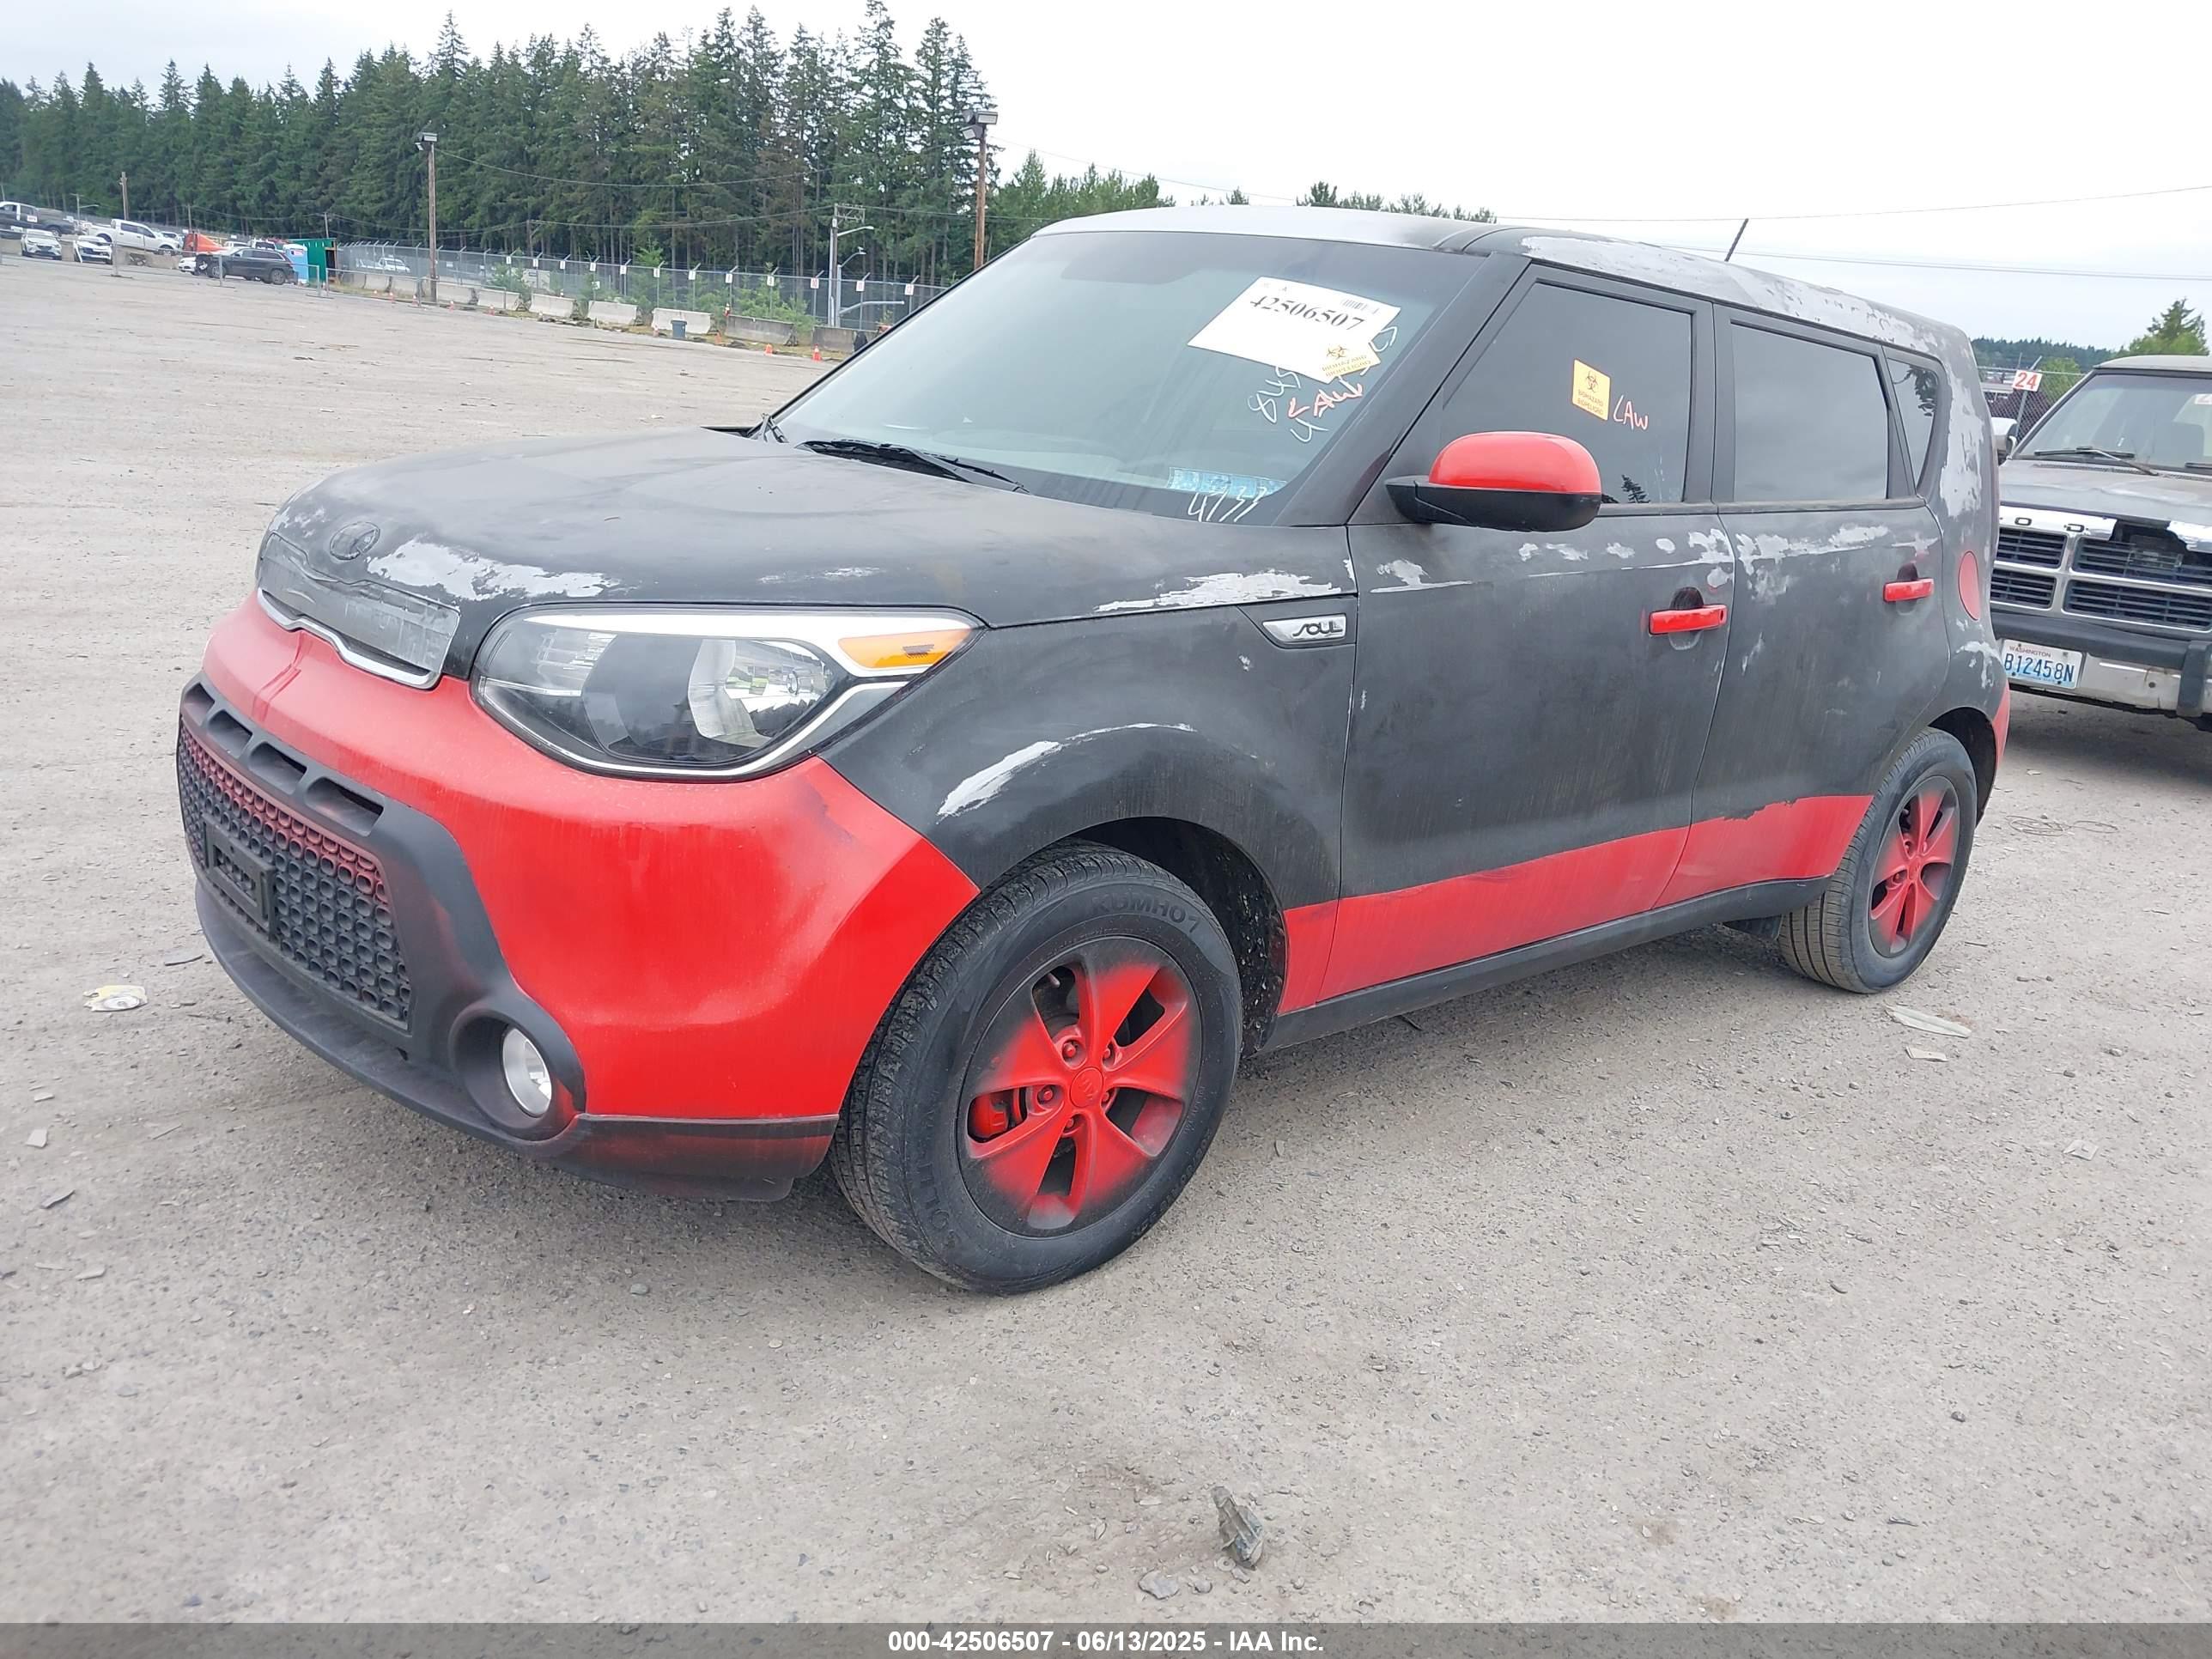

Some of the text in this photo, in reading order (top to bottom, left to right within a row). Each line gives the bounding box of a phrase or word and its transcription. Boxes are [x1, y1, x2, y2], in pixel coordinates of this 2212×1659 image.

[1249, 295, 1366, 331] 42506507
[2014, 372, 2039, 390] 24
[1291, 620, 1344, 637] SOUL
[2008, 645, 2051, 658] WASHINGTON
[2003, 653, 2075, 683] B12458N
